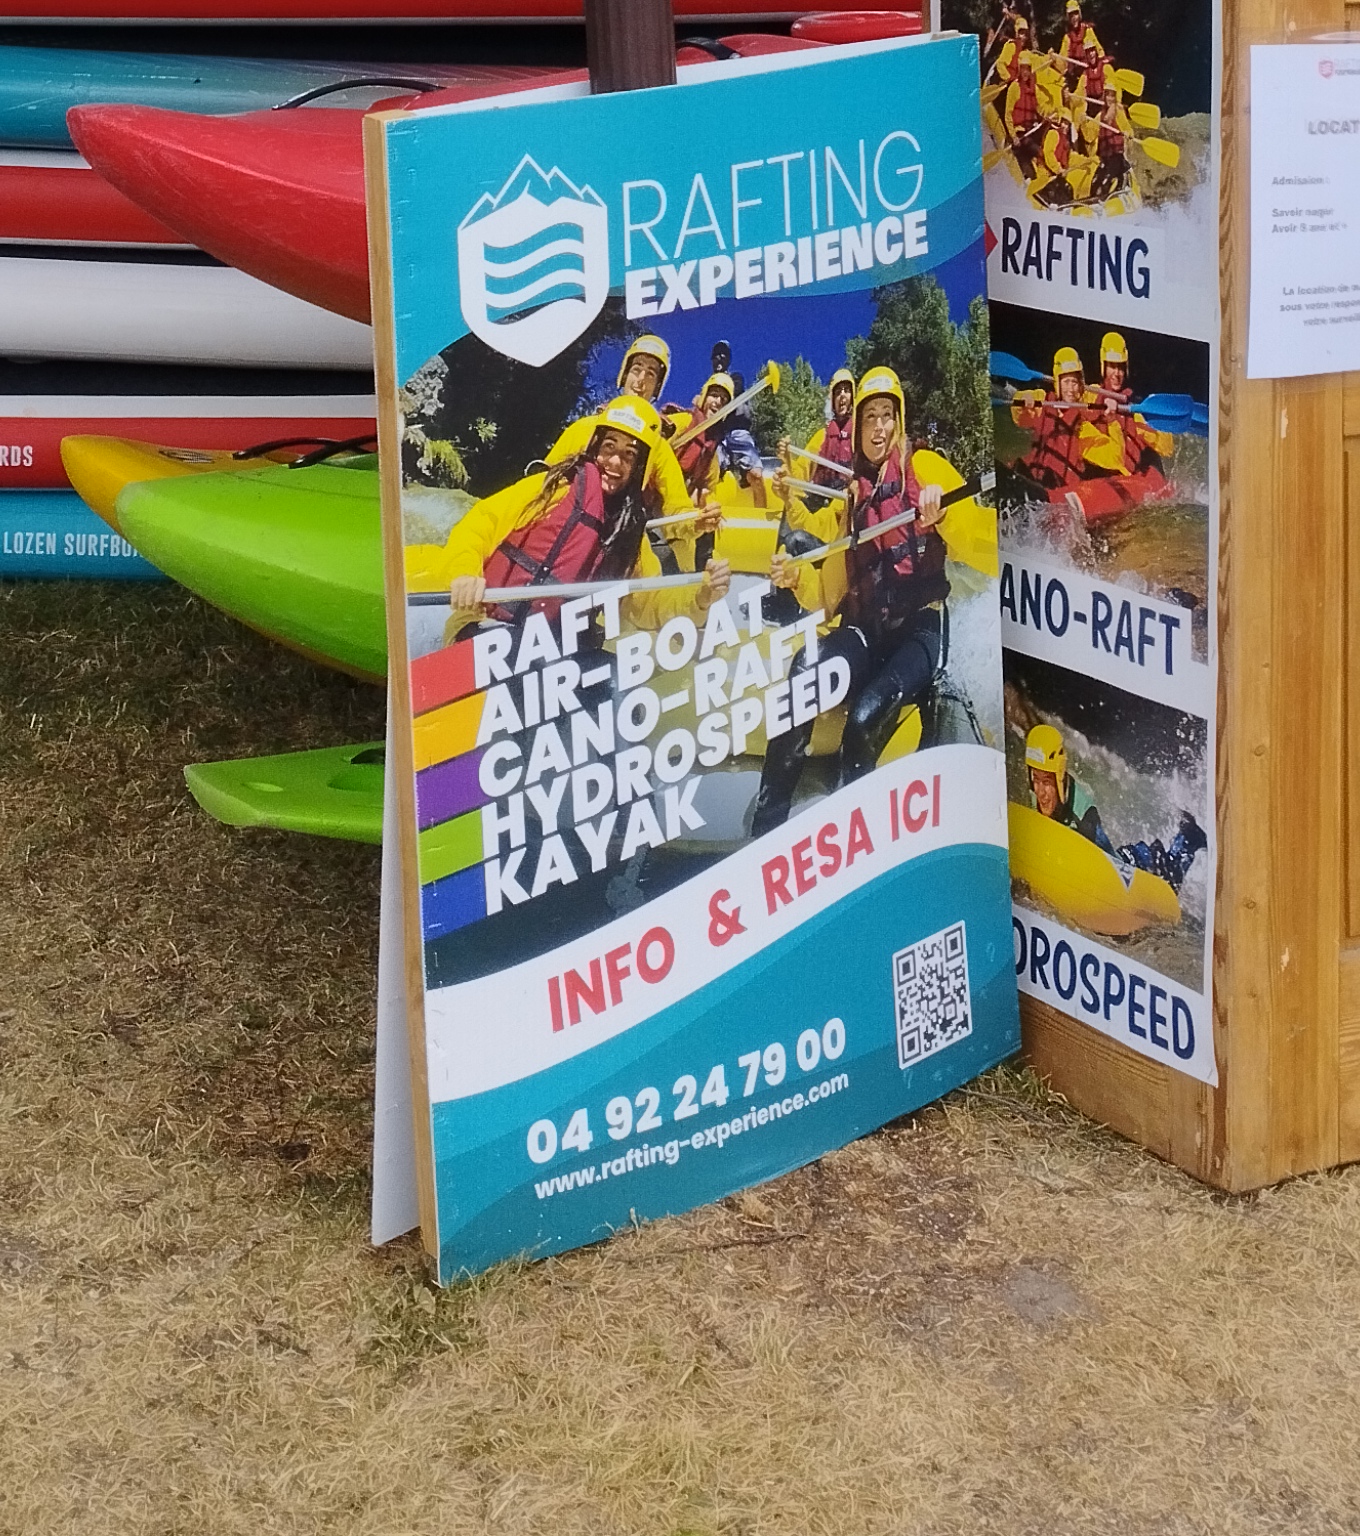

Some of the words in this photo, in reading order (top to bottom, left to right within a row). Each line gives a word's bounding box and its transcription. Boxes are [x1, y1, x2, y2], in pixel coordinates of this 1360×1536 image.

[623, 130, 925, 267] RAFTING
[626, 208, 929, 321] EXPERIENCE
[1001, 217, 1150, 299] RAFTING
[3, 531, 56, 555] LOZEN
[64, 532, 138, 557] SURFBO
[473, 580, 632, 689] RAFT
[476, 580, 771, 745] AIR-BOAT
[1000, 563, 1180, 675] ANO-RAFT
[478, 609, 827, 798] CANO-RAFT
[481, 656, 851, 861] HYDROSPEED
[485, 778, 706, 916] KAYAK
[548, 924, 675, 1032] INFO
[708, 889, 746, 947] &
[763, 815, 876, 918] RESA
[889, 775, 943, 843] ICI
[1013, 916, 1195, 1060] DROSPEED
[527, 1107, 593, 1163] 04
[606, 1087, 662, 1140] 92
[673, 1064, 729, 1121] 24
[738, 1042, 786, 1097] 79
[797, 1017, 846, 1071] 00
[534, 1073, 848, 1199] www.rafting-experience.com
